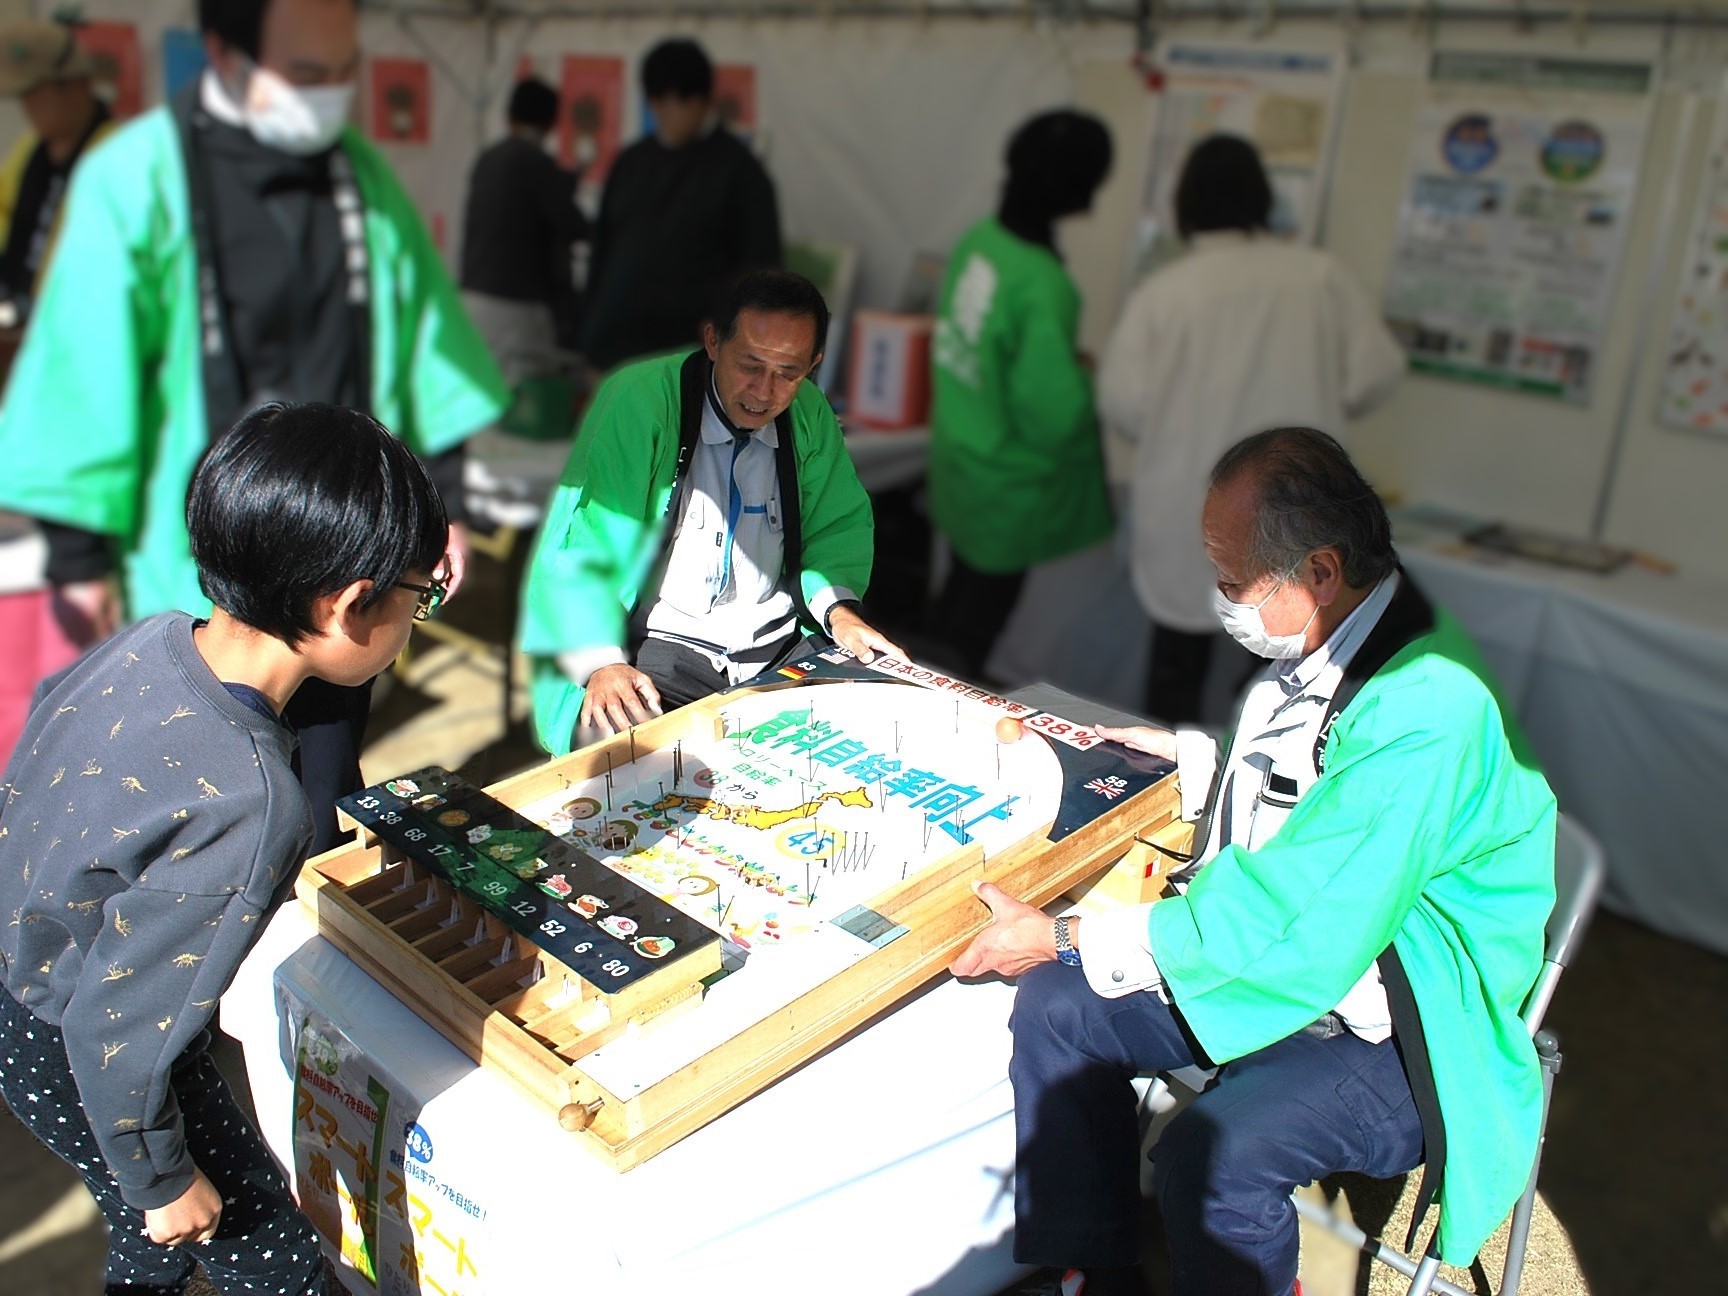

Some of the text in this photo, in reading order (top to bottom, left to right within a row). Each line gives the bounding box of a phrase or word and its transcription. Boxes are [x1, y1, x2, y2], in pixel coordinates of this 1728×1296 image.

[877, 657, 1092, 747] 日本の食料自給率 38%
[724, 708, 1021, 846] 食料自給率向上
[726, 784, 759, 800] から
[356, 794, 631, 979] 13 38 68 17 7 99 12 52 6 80
[788, 831, 835, 856] 45
[297, 1085, 379, 1183] スマート
[406, 1128, 433, 1160] 38%
[383, 1169, 478, 1278] スマート
